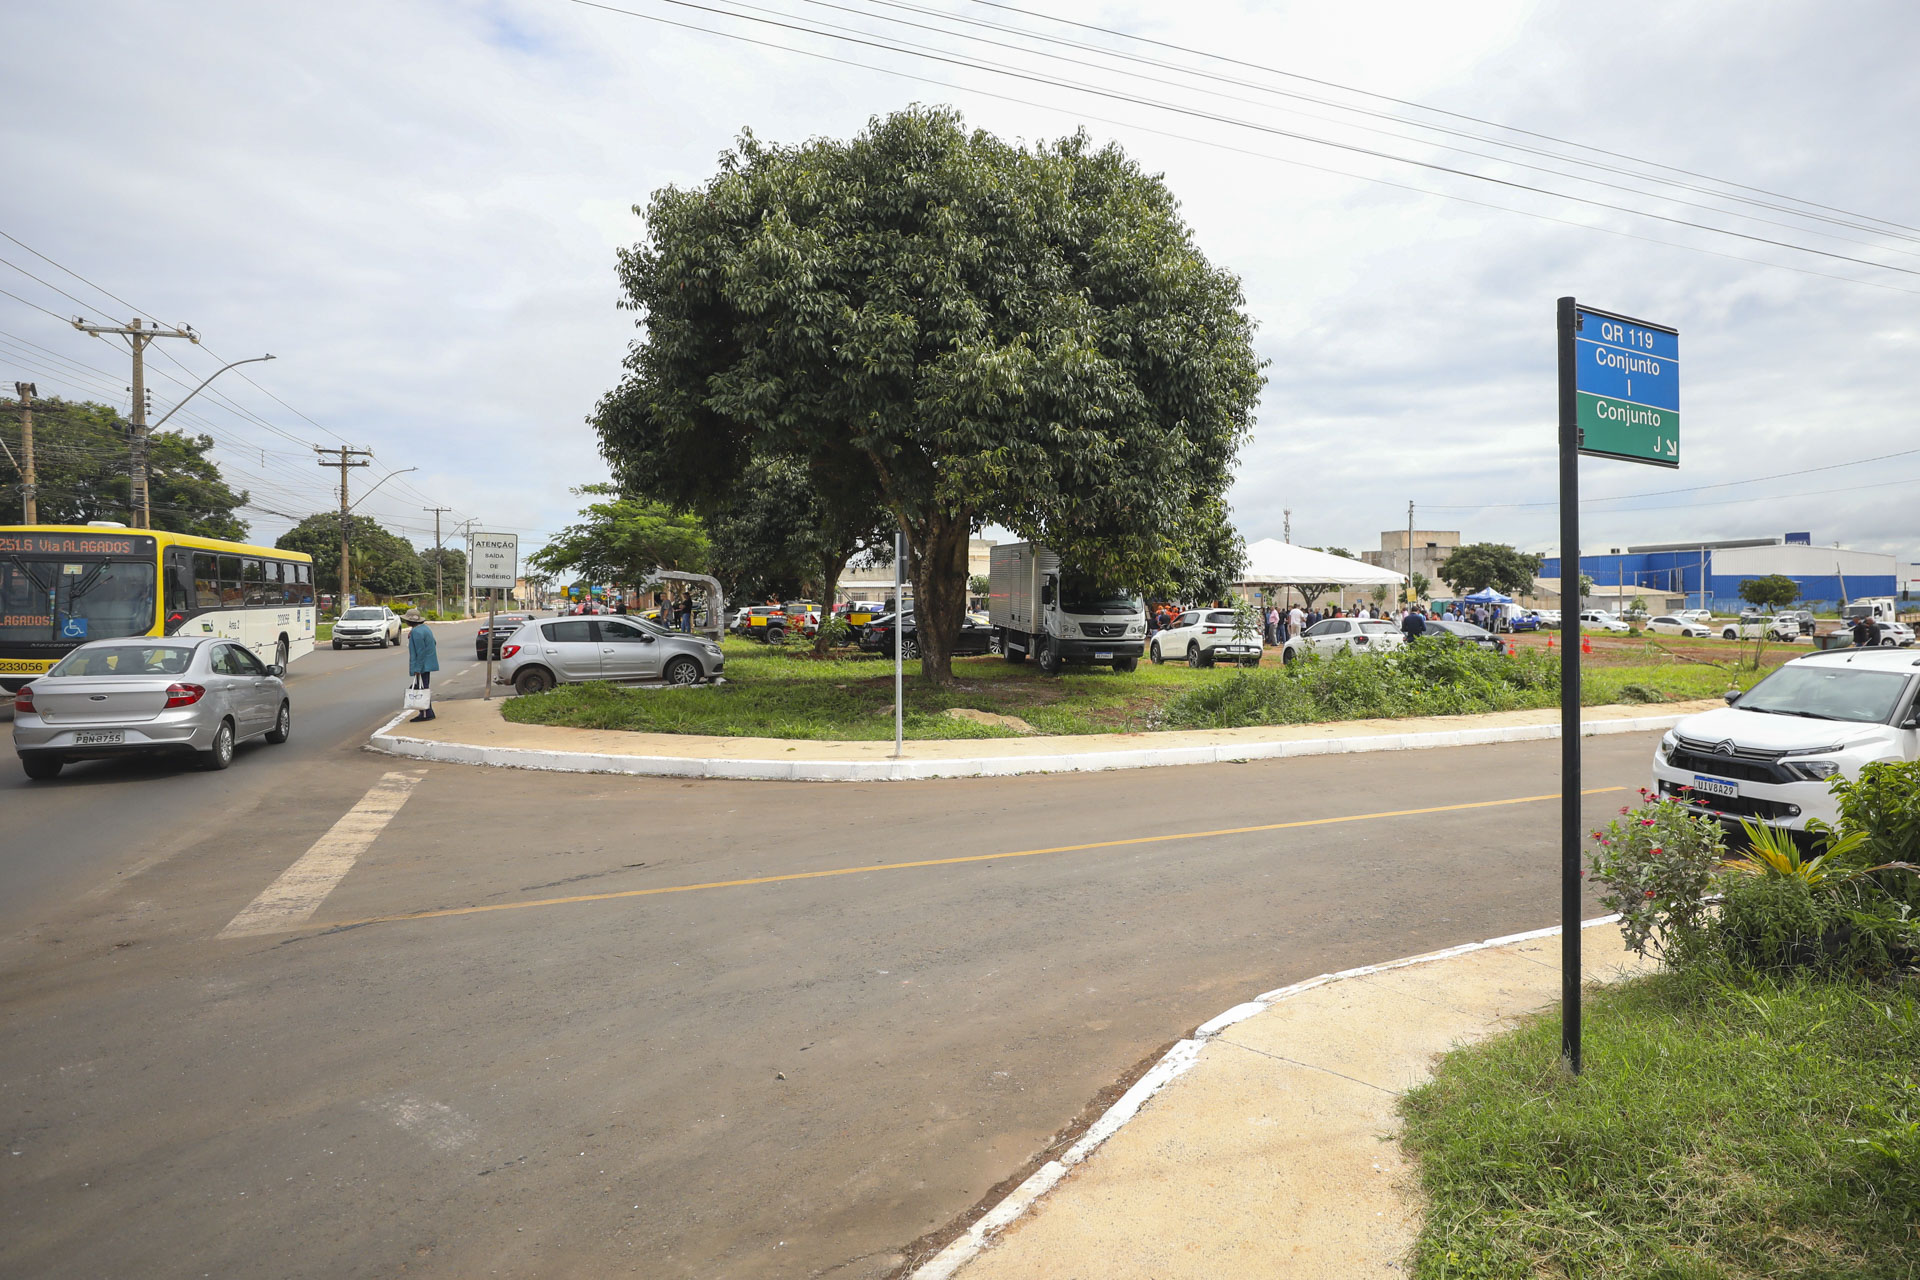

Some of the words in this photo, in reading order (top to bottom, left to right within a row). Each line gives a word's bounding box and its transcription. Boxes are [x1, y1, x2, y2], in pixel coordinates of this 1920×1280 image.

[1601, 322, 1623, 343] QR
[1629, 330, 1653, 349] 119
[1596, 347, 1660, 375] Conjunto
[1596, 400, 1661, 427] Conjunto
[1653, 436, 1661, 453] J
[40, 539, 60, 552] Via
[63, 540, 130, 553] ALAGADOS
[475, 541, 514, 549] ATENÇÃO
[0, 662, 43, 671] 233056
[1698, 781, 1734, 795] UIV8A29
